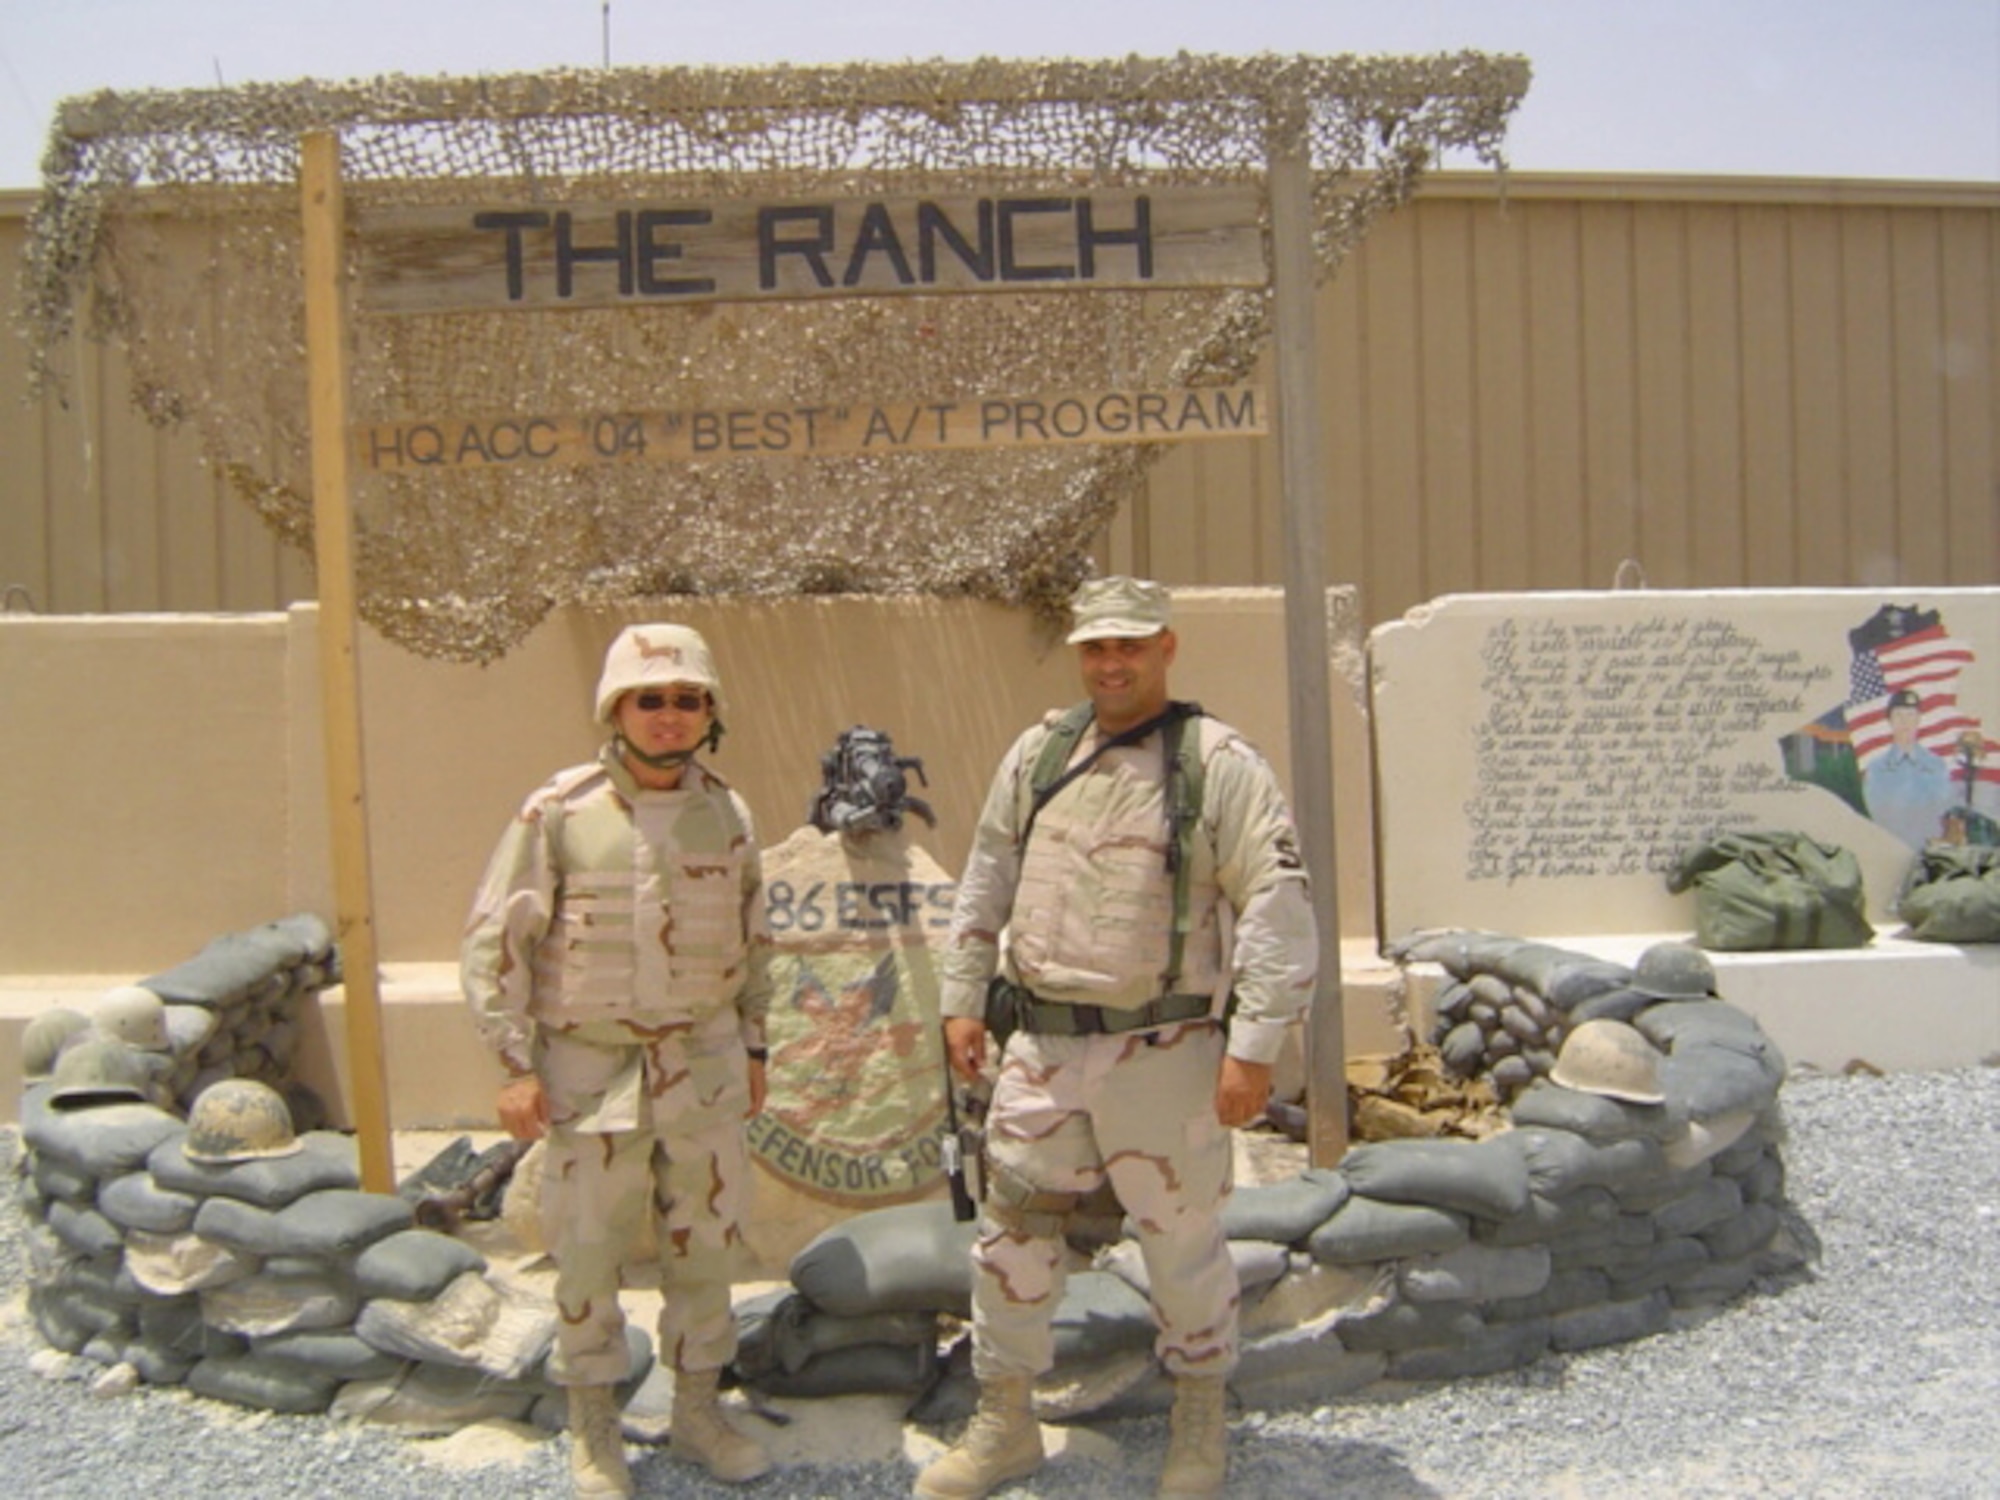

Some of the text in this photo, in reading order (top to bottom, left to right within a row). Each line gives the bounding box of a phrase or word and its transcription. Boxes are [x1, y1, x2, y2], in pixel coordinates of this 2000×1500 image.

[474, 195, 1154, 300] THE RANCH
[369, 425, 446, 469] HQ
[455, 417, 559, 464] ACC
[861, 403, 958, 447] A/T
[981, 389, 1257, 441] PROGRAM
[836, 881, 959, 929] ESFS
[746, 1112, 889, 1190] EFENSOR
